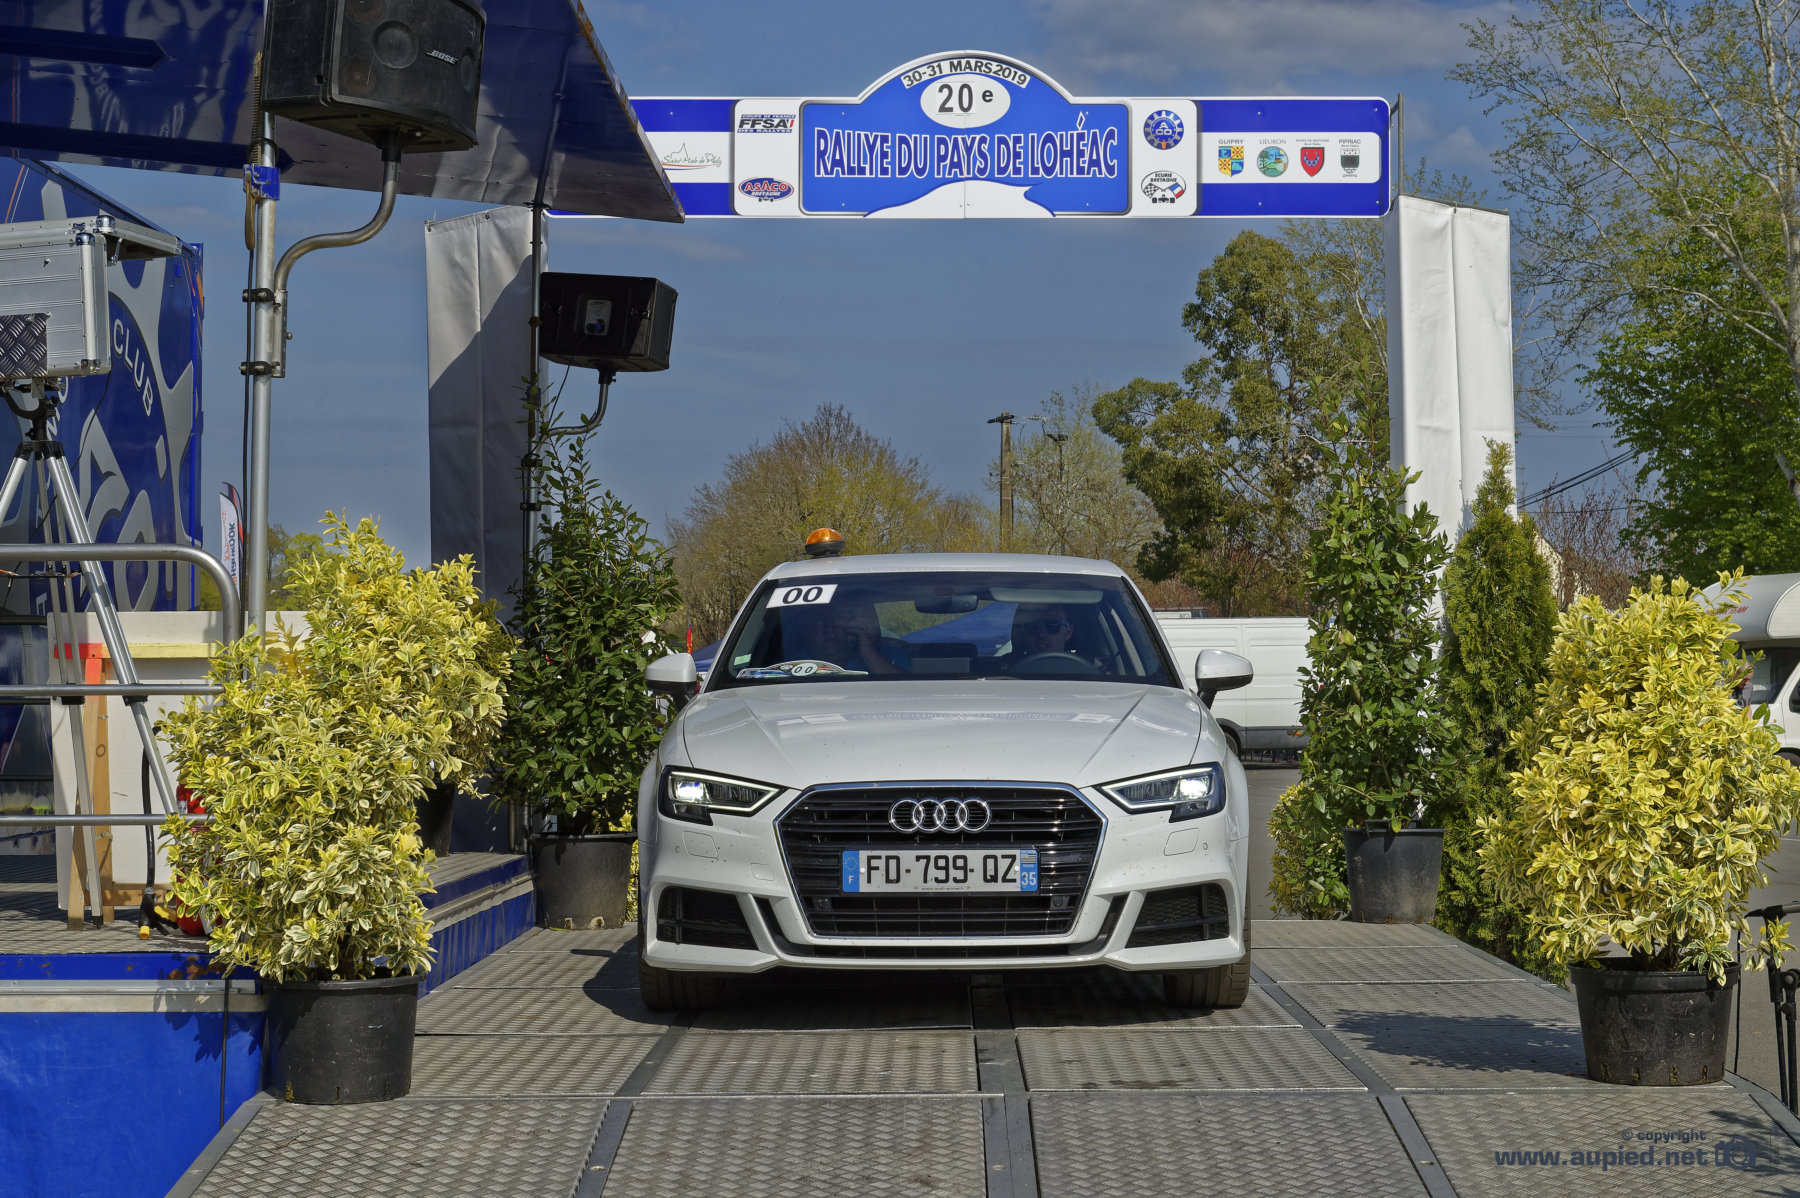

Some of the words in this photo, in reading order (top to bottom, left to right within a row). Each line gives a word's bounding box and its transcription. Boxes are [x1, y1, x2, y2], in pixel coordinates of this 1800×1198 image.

[902, 62, 944, 87] 30-31
[949, 59, 993, 74] MARS
[993, 64, 1028, 86] 2019
[937, 83, 974, 113] 20
[738, 118, 788, 129] FFSA
[814, 127, 892, 178] RALLYE
[896, 133, 930, 179] DU
[935, 133, 991, 179] PAYS
[995, 133, 1024, 178] DE
[1029, 112, 1118, 179] LOHÉAC
[113, 318, 154, 417] CLUB
[847, 874, 855, 884] F
[1020, 871, 1037, 886] 35
